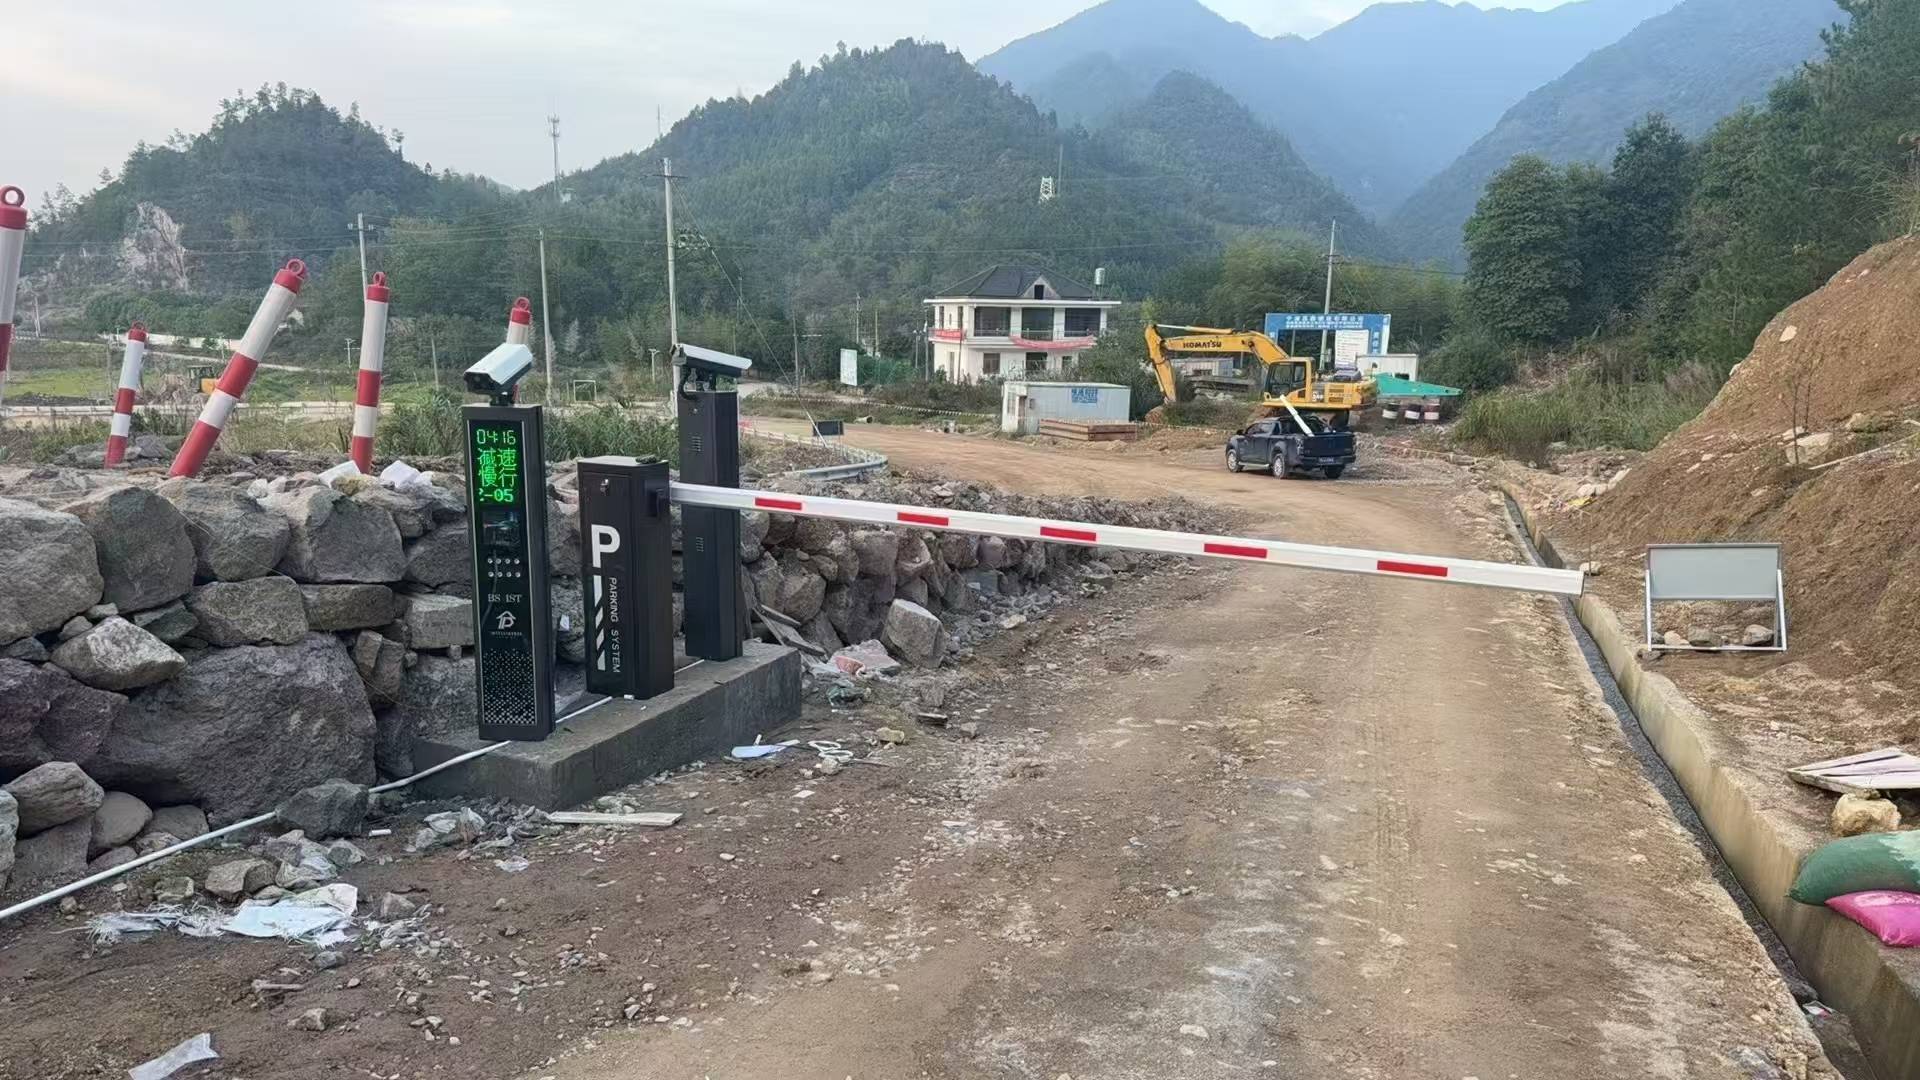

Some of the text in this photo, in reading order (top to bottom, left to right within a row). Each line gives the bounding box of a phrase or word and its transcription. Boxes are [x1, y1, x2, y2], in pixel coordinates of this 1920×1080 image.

[1183, 341, 1222, 349] KOMATSU
[477, 448, 517, 466] 减速
[478, 467, 518, 487] 慢行
[591, 524, 621, 568] P
[608, 577, 618, 623] PARKING
[611, 629, 621, 673] SYSTEM
